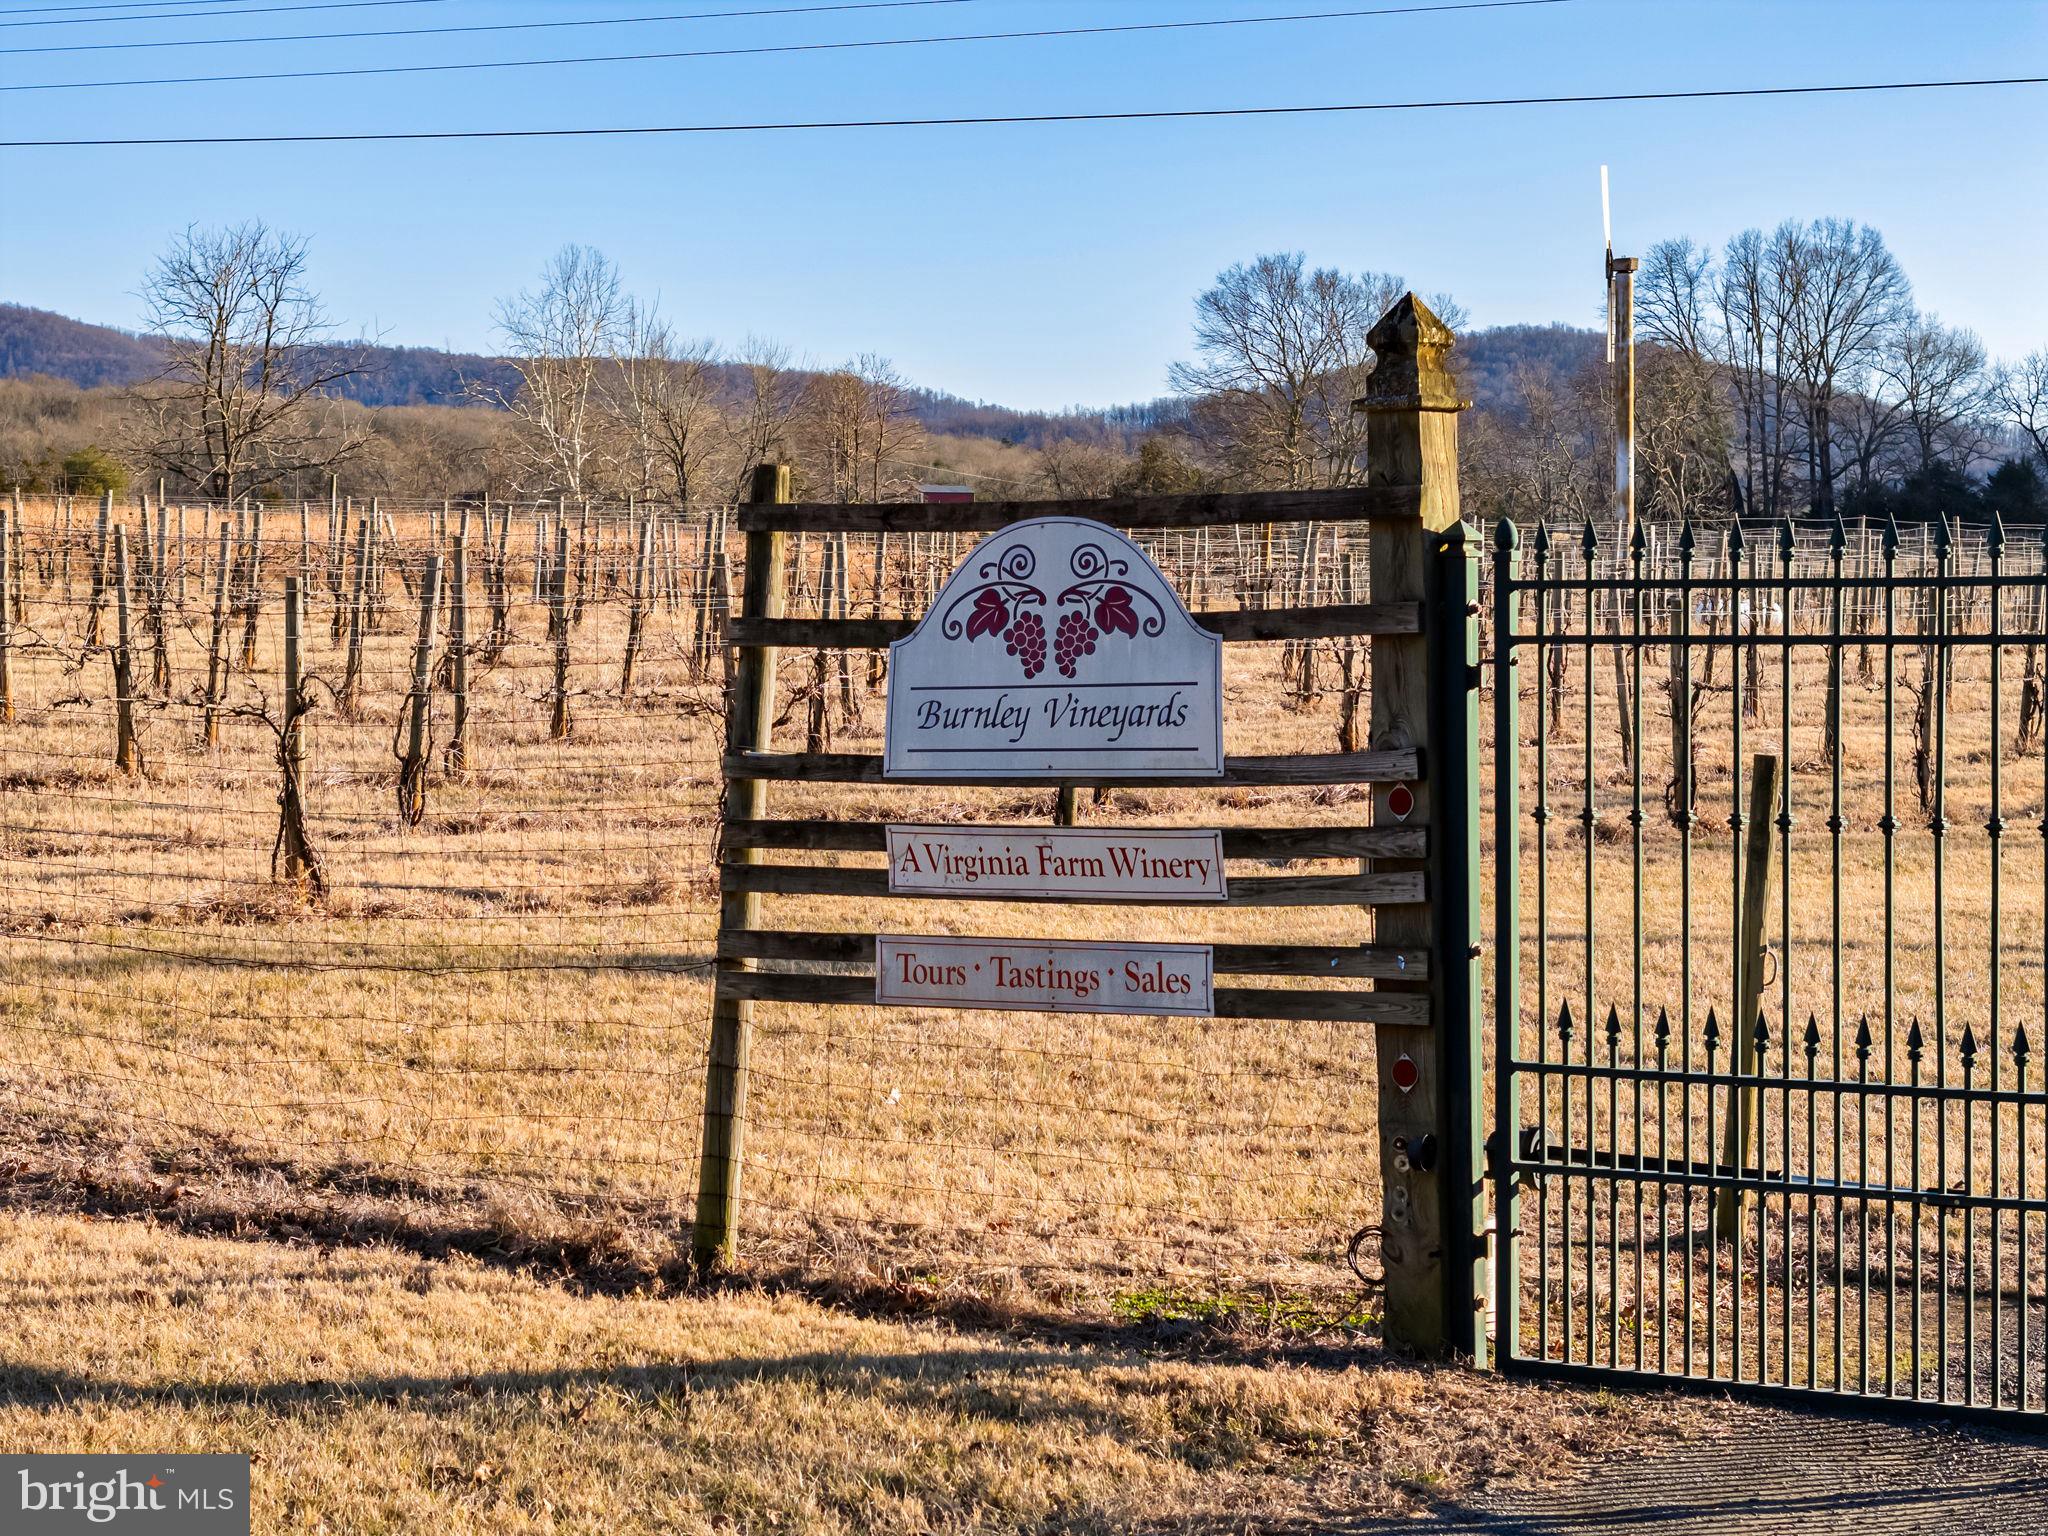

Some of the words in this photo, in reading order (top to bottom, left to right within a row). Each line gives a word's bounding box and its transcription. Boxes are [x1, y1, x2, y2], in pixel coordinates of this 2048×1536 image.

[917, 693, 1031, 743] Burnley
[1044, 691, 1188, 743] Vineyards
[900, 842, 922, 873] A
[922, 843, 1031, 882] Virginia
[1035, 844, 1104, 878] Farm
[1106, 846, 1211, 886] Winery
[895, 952, 967, 986] Tours
[989, 955, 1100, 998] Tastings
[1124, 960, 1191, 994] Sales
